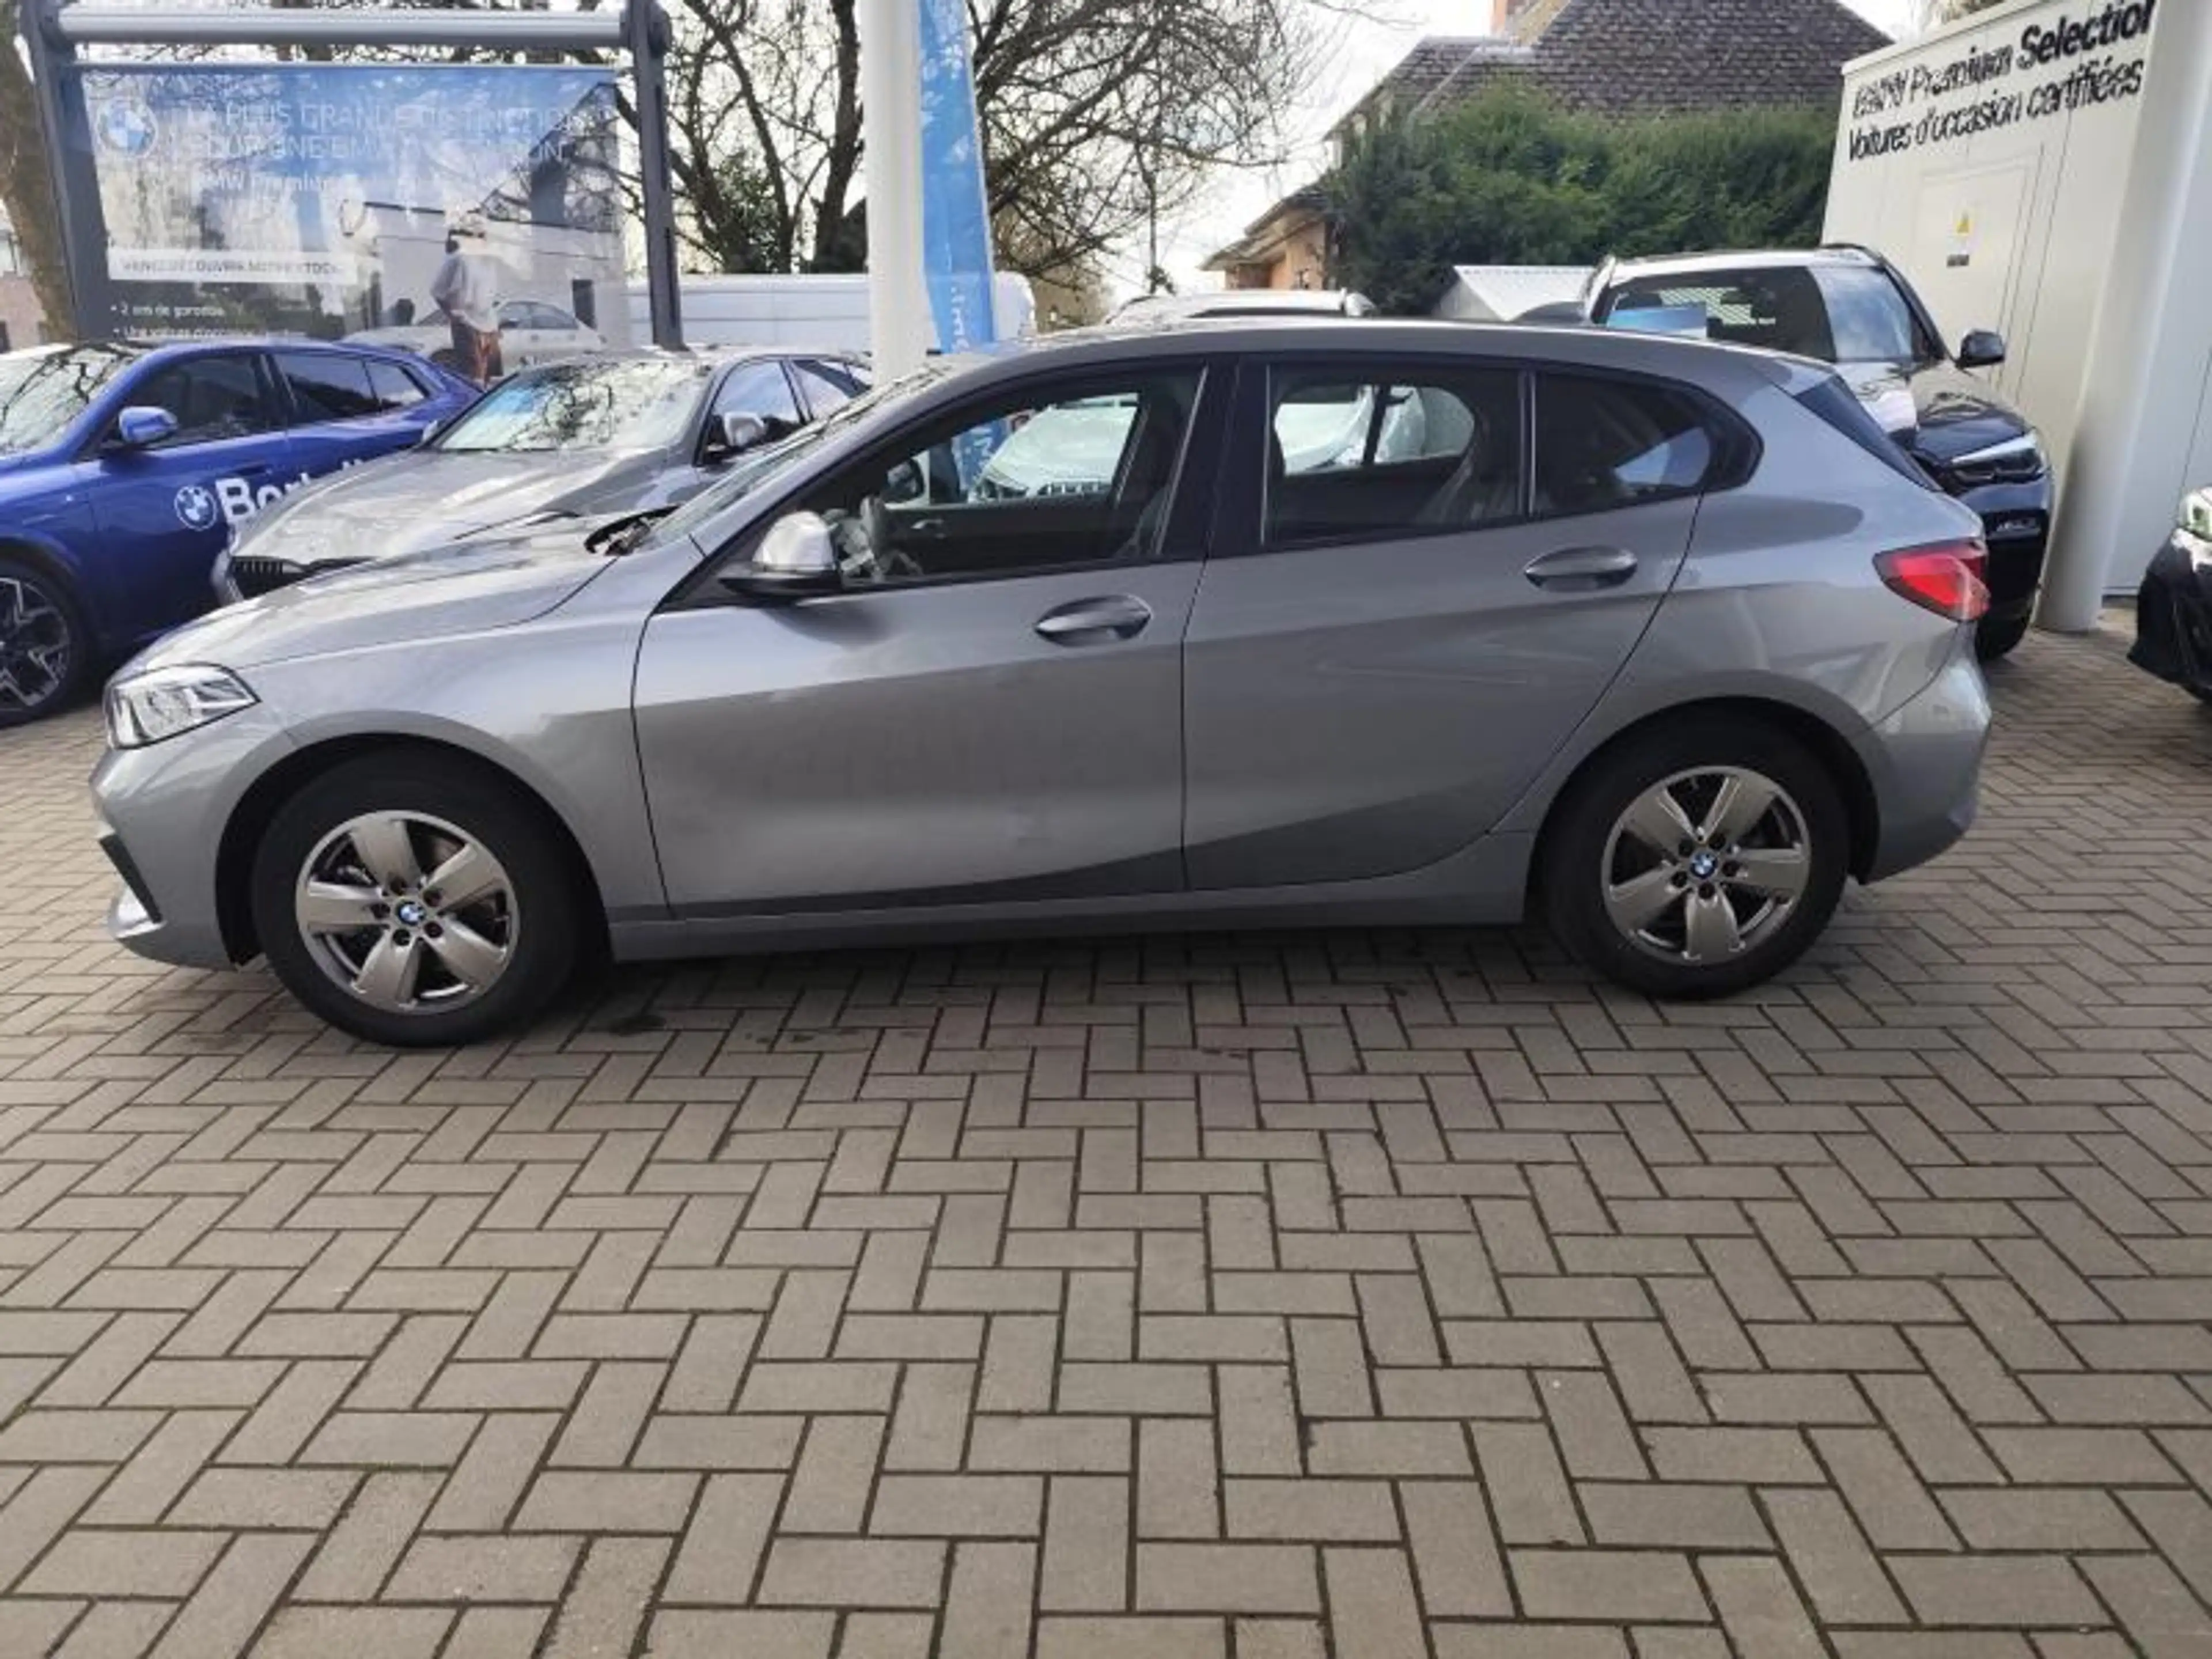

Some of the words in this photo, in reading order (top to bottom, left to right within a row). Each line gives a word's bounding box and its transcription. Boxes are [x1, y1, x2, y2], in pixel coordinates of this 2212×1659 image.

[1849, 123, 1911, 162] Voitures
[1915, 88, 2022, 145] d'occasion
[2027, 55, 2144, 119] certifiées
[1909, 44, 2013, 104] Premium
